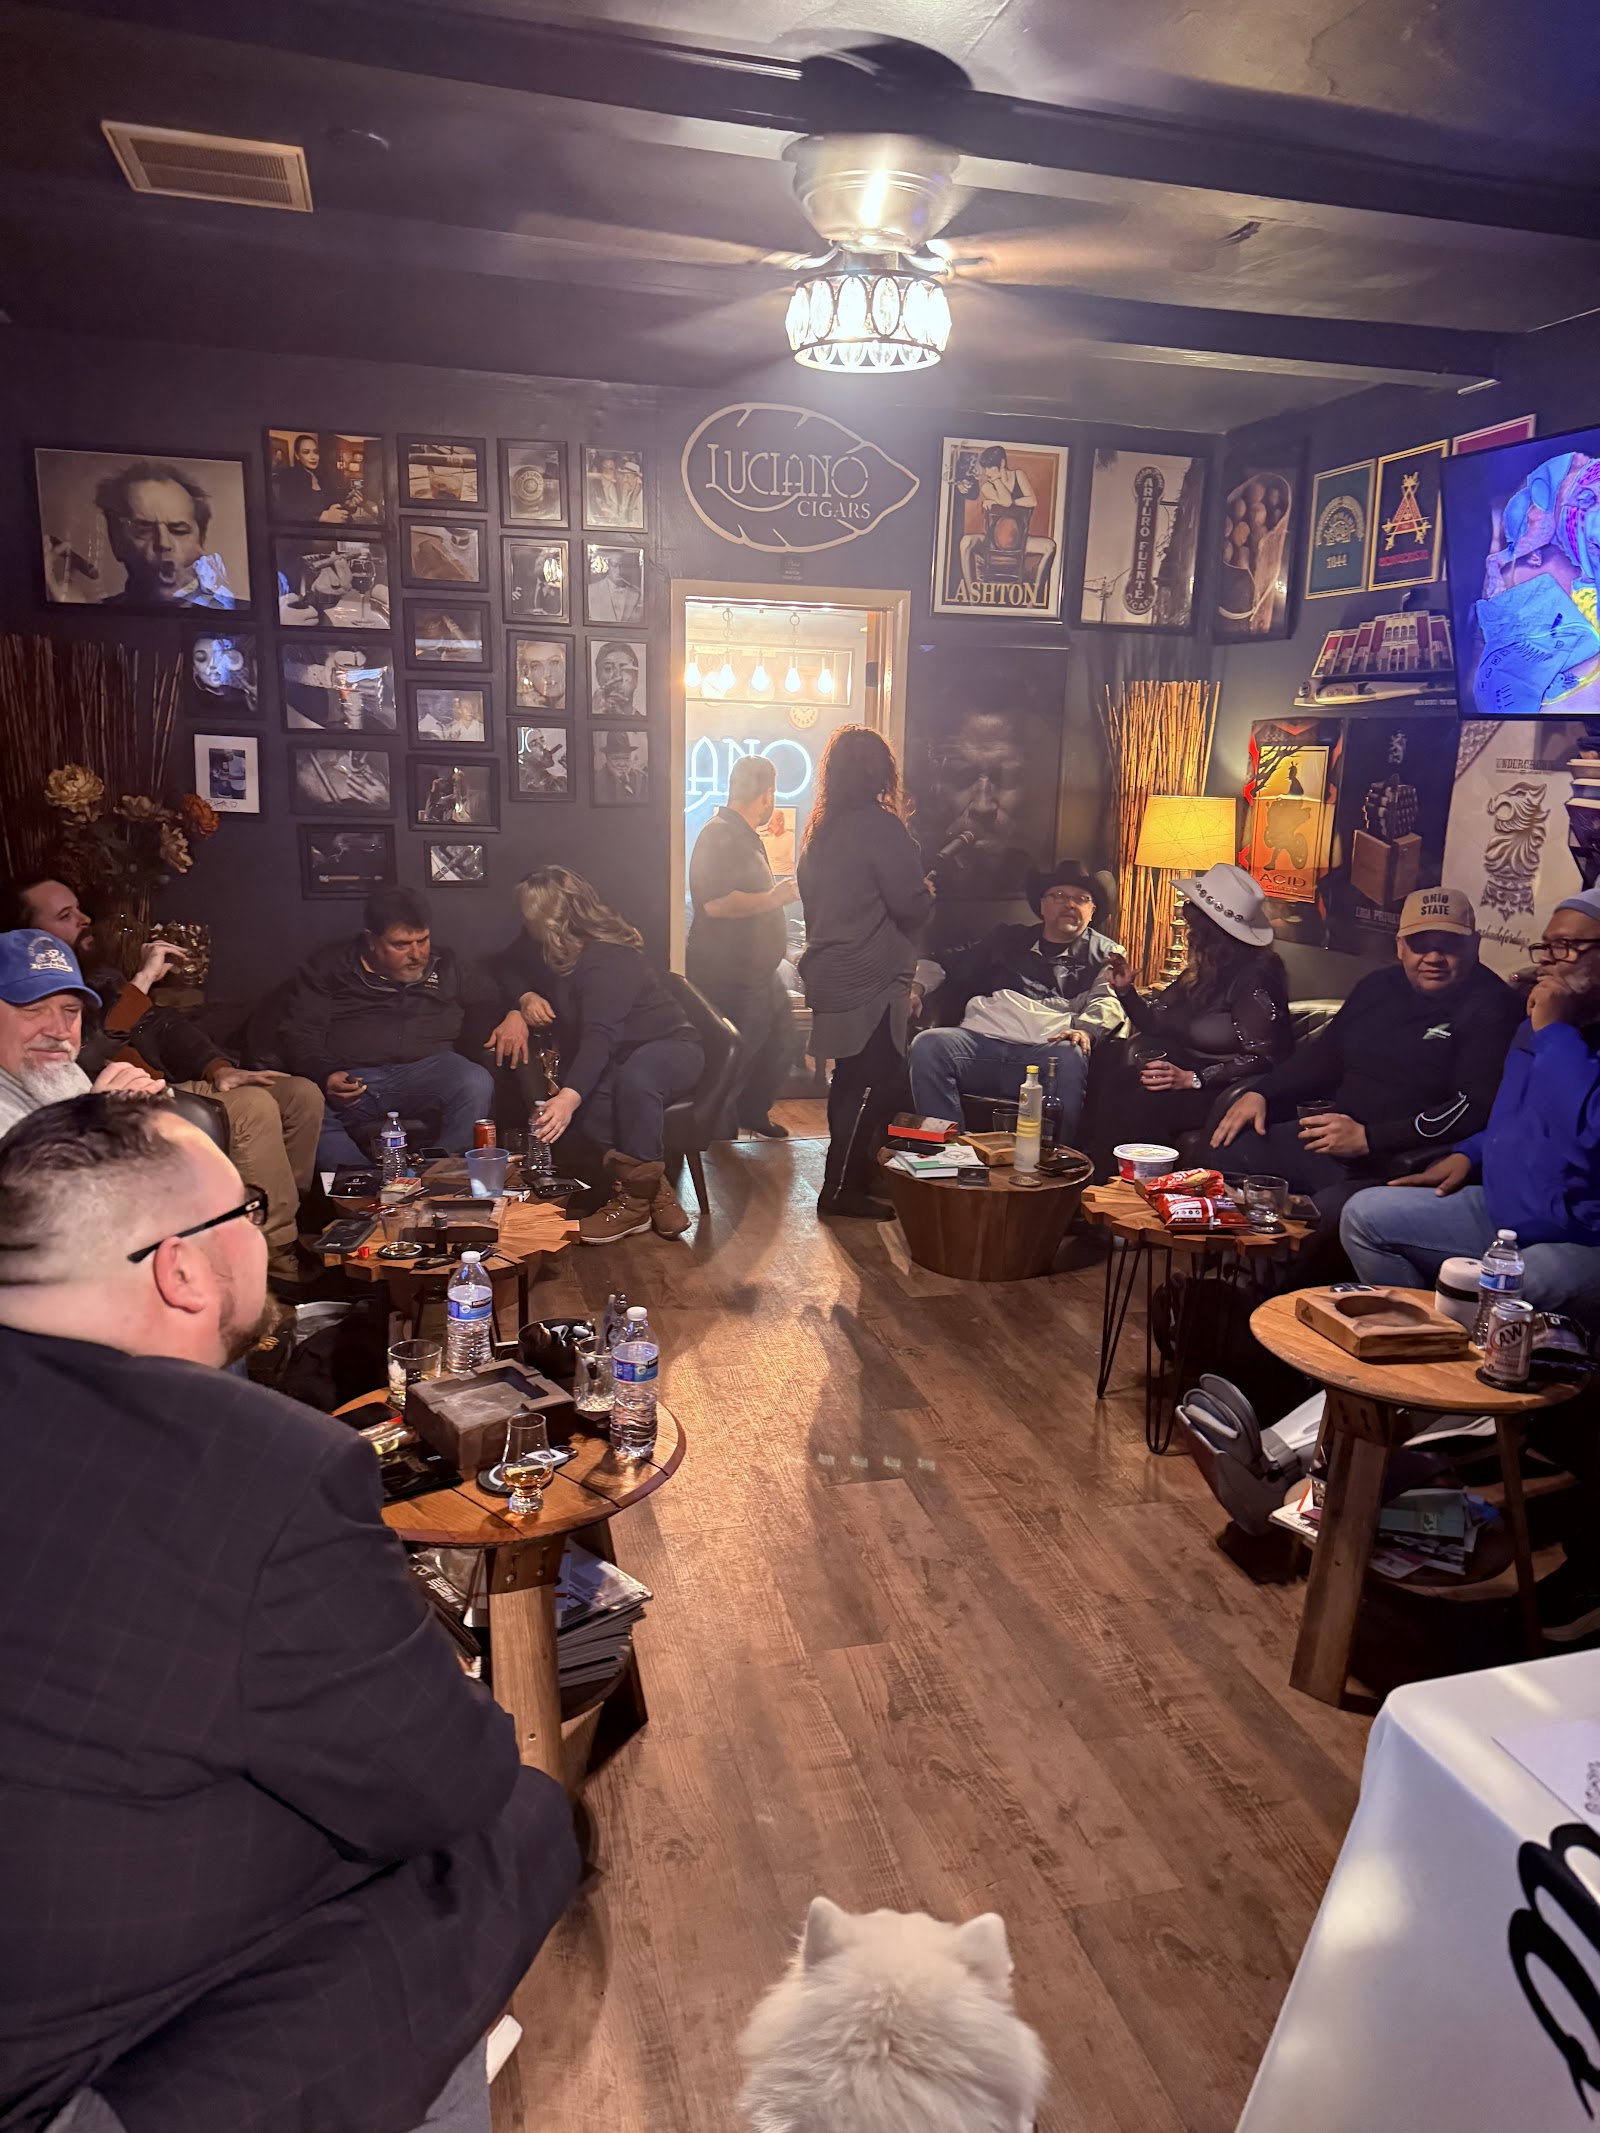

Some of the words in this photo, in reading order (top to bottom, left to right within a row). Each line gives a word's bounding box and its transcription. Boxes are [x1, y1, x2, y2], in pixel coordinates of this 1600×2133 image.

[705, 443, 869, 512] LUCIANO
[797, 501, 870, 519] CIGARS
[1139, 477, 1154, 537] ARTURO
[1134, 541, 1149, 599] FUENTE
[954, 579, 1039, 606] ASHTON
[1260, 873, 1306, 887] ACID
[1422, 893, 1449, 904] OHIO
[1420, 905, 1450, 916] STATE
